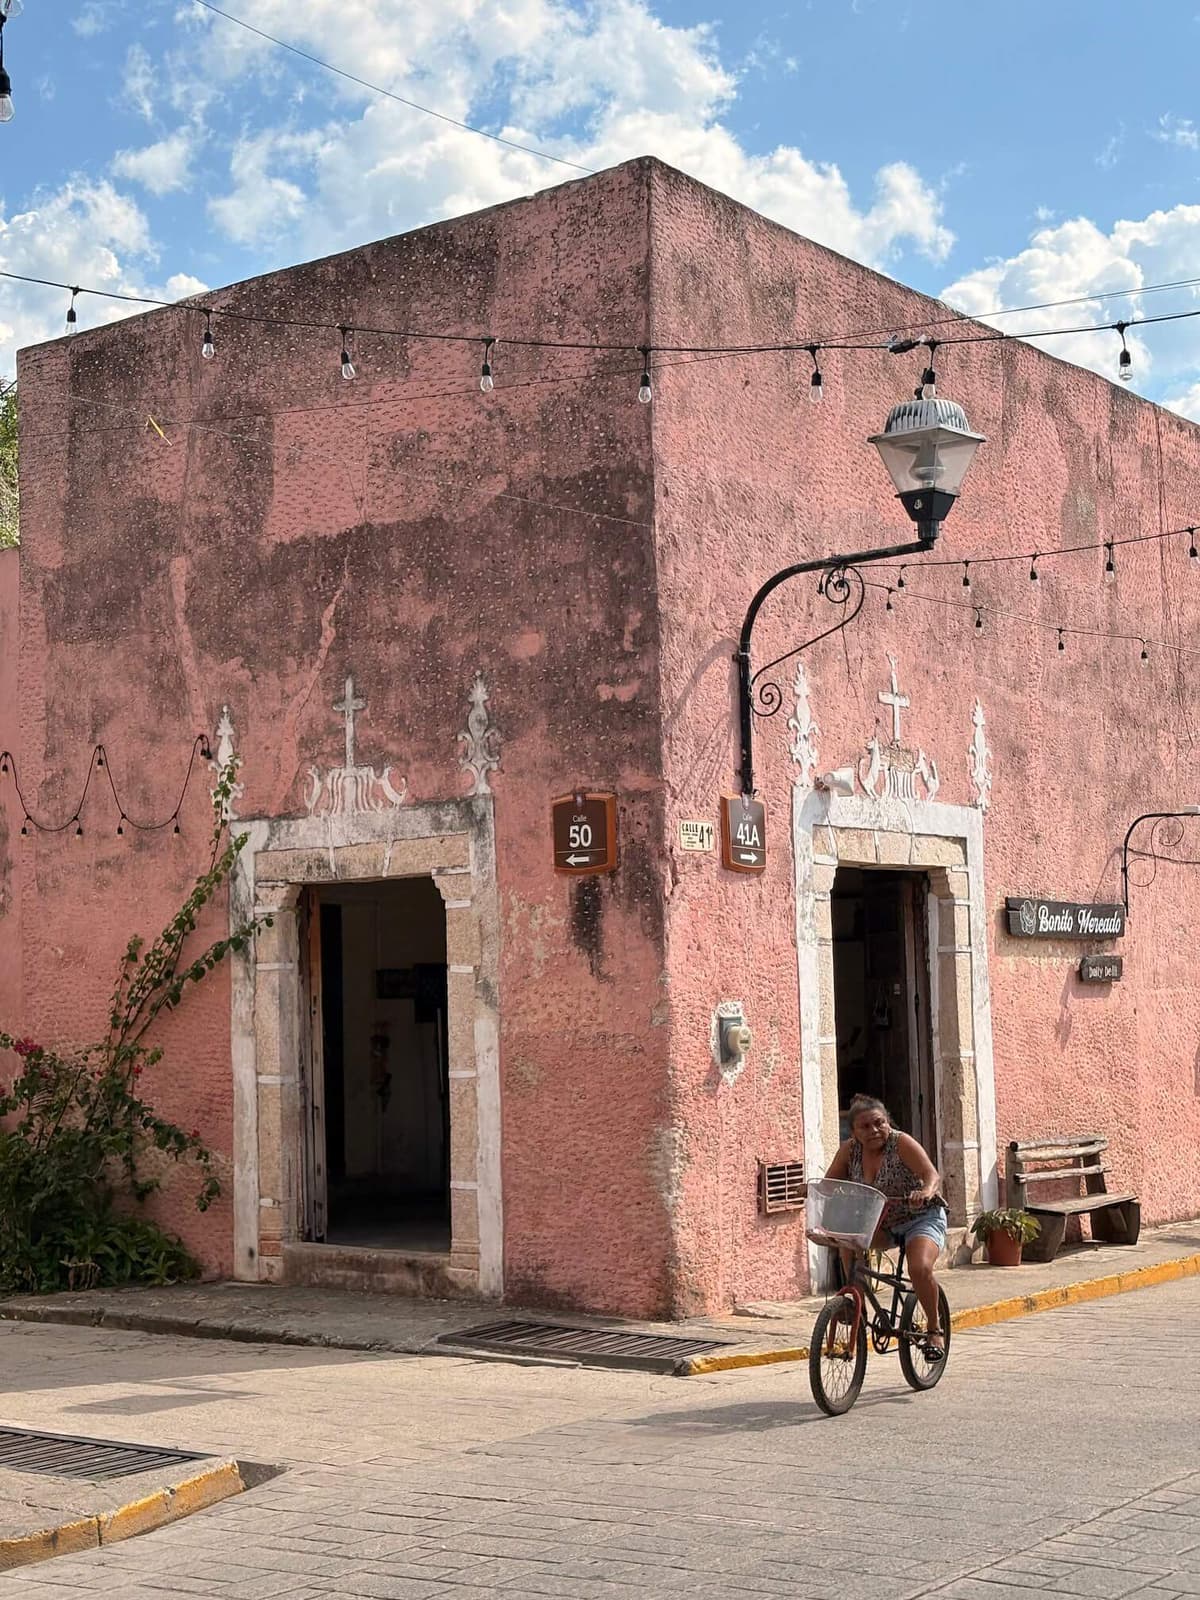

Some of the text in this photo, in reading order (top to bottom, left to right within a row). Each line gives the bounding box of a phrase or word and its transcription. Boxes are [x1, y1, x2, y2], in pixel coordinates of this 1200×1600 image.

[572, 814, 587, 823] Calle
[681, 823, 698, 833] CALLE
[569, 824, 592, 848] 50
[736, 823, 761, 847] 41A
[1038, 905, 1121, 934] Bonito Mercado
